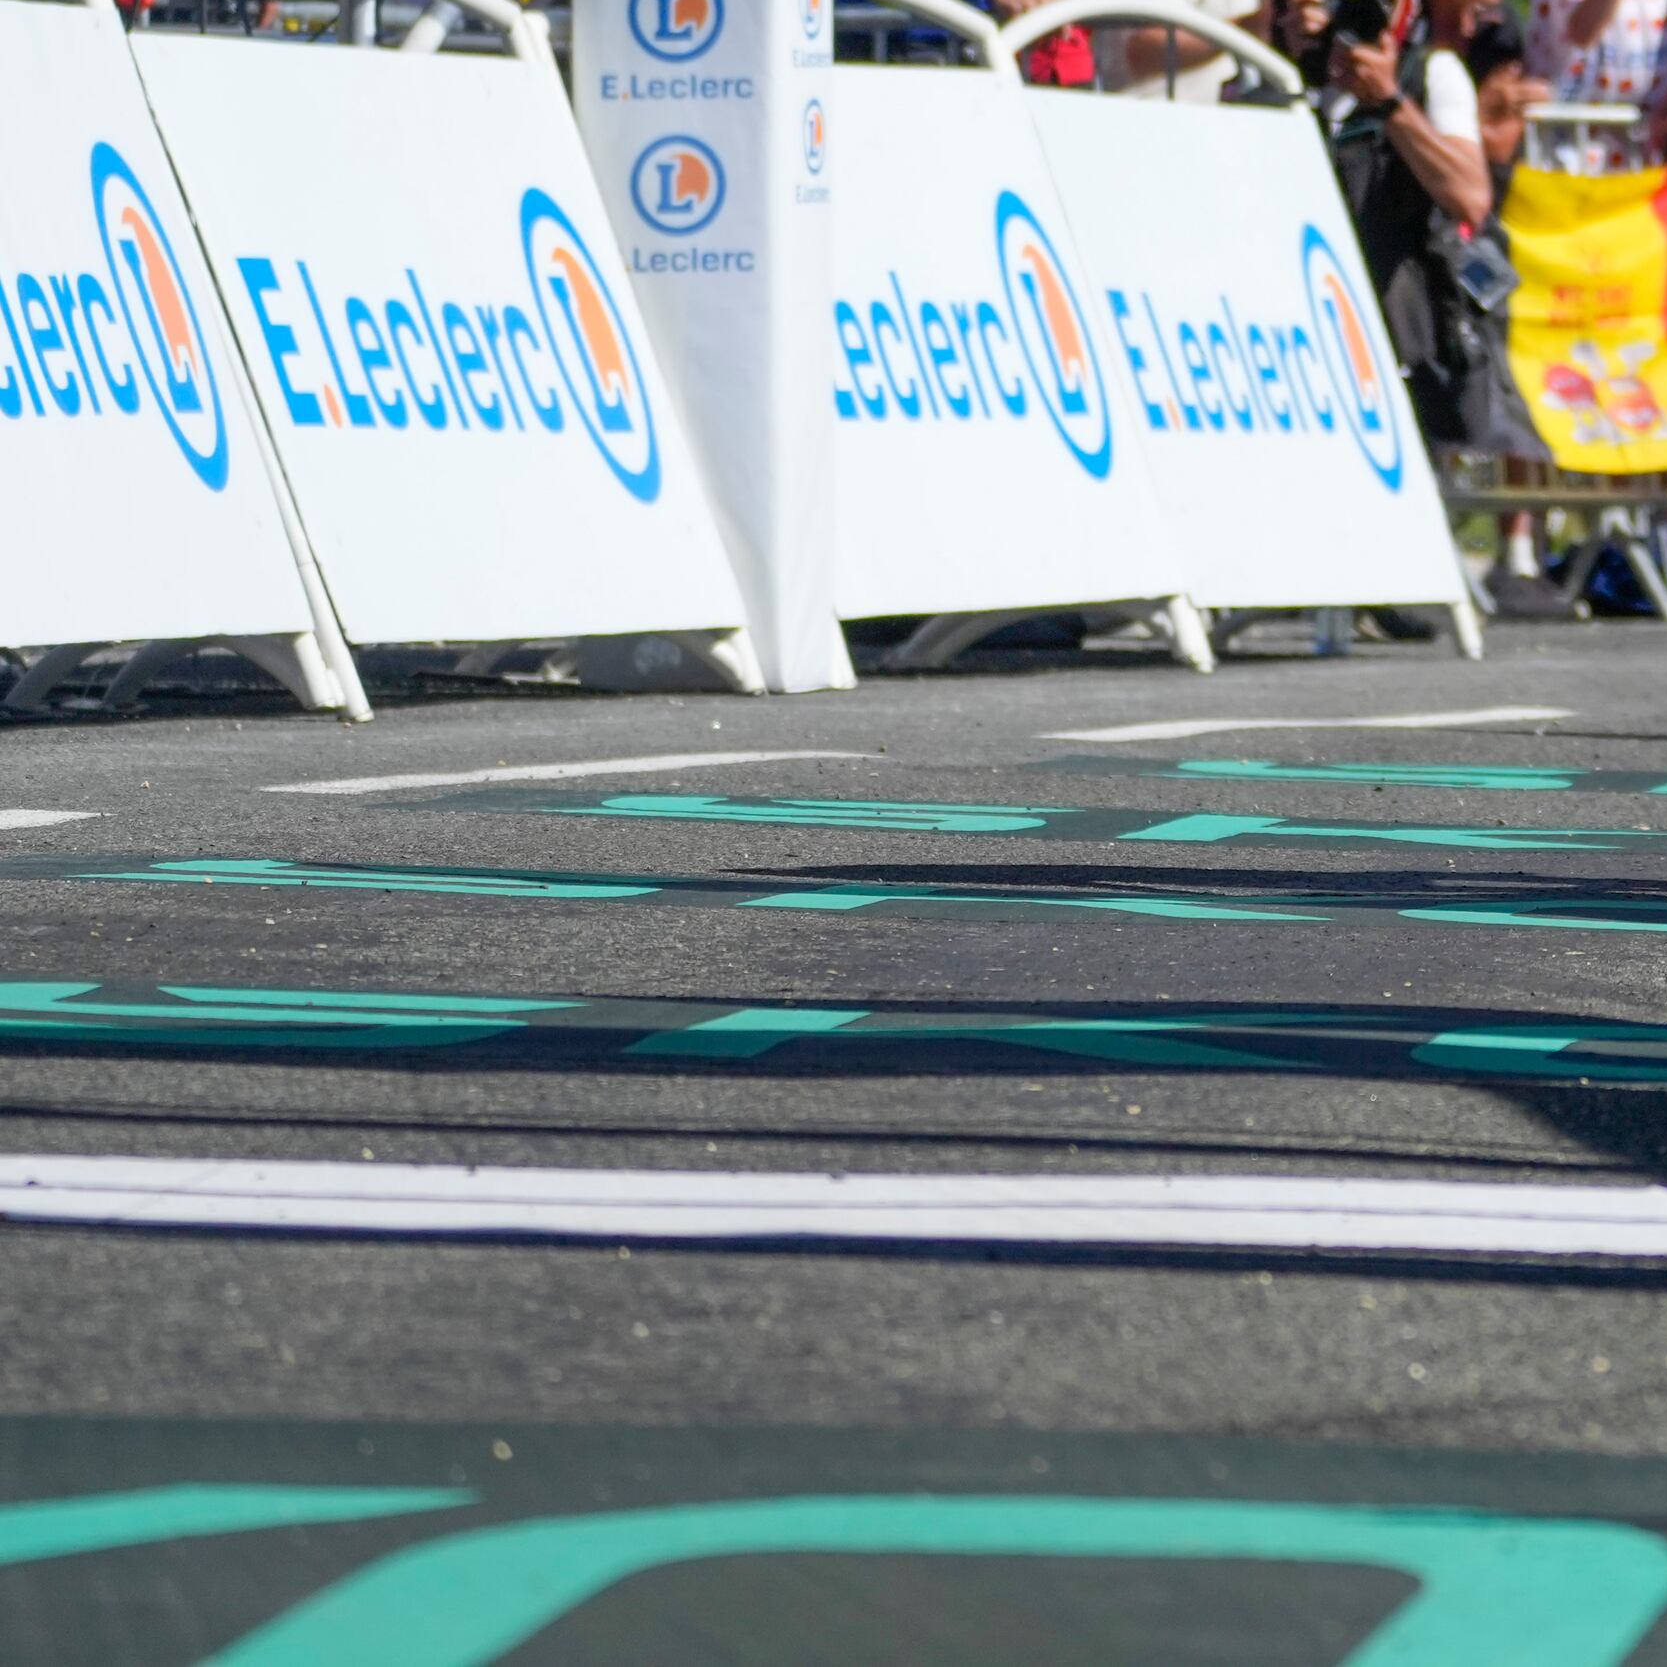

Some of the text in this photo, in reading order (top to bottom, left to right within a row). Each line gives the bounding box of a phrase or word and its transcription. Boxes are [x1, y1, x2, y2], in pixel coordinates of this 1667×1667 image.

[600, 74, 755, 102] E.Leclerc
[625, 247, 756, 274] .Leclerc
[235, 256, 565, 433] E.Leclerc
[1105, 287, 1336, 434] E.Leclerc
